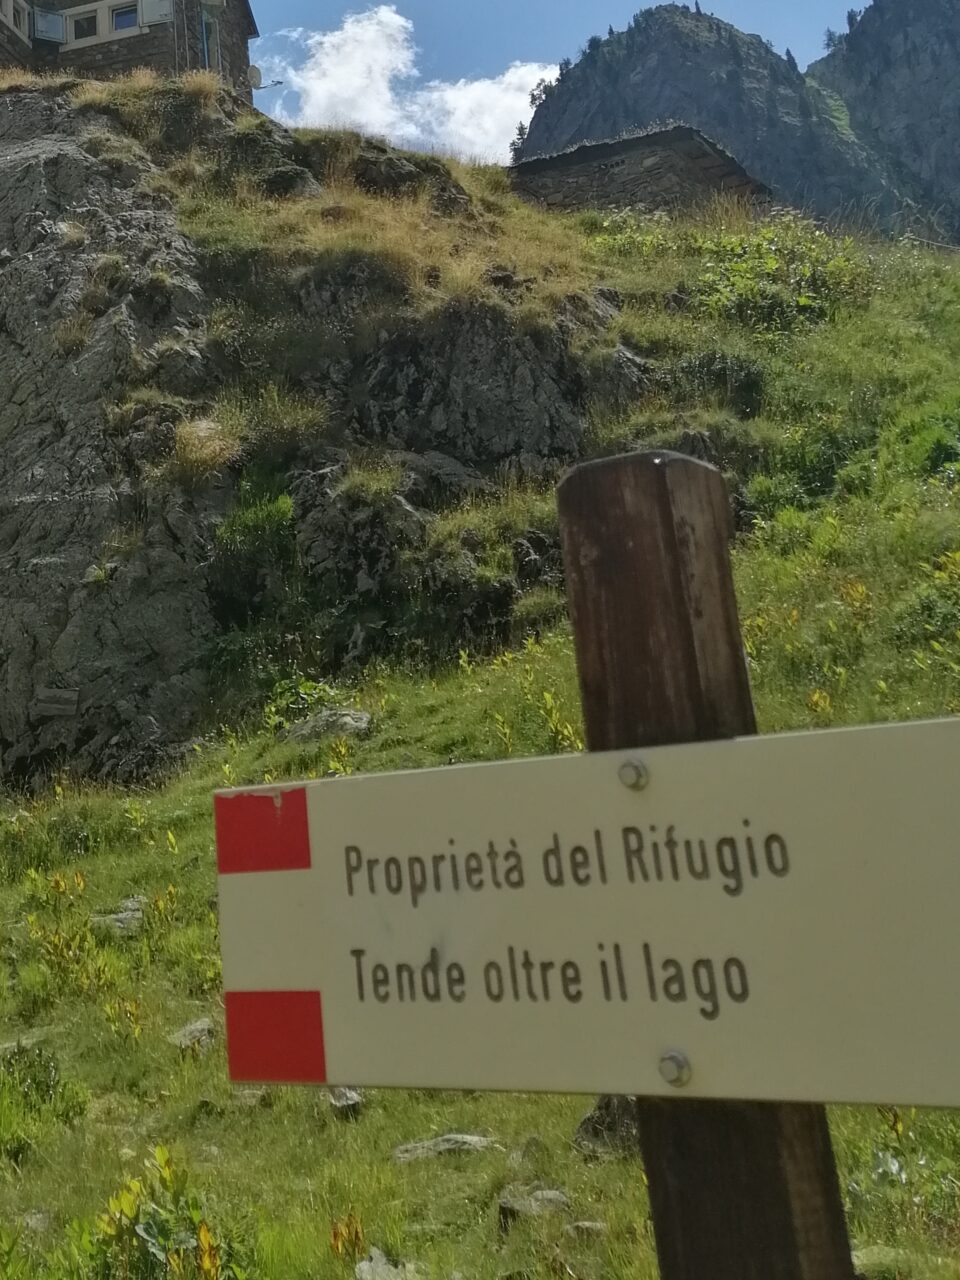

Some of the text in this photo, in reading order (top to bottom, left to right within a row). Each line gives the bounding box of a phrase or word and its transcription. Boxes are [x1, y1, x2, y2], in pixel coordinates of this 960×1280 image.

[344, 818, 791, 908] Proprietà del Rifugio
[349, 942, 751, 1021] Tende oltre il lago
